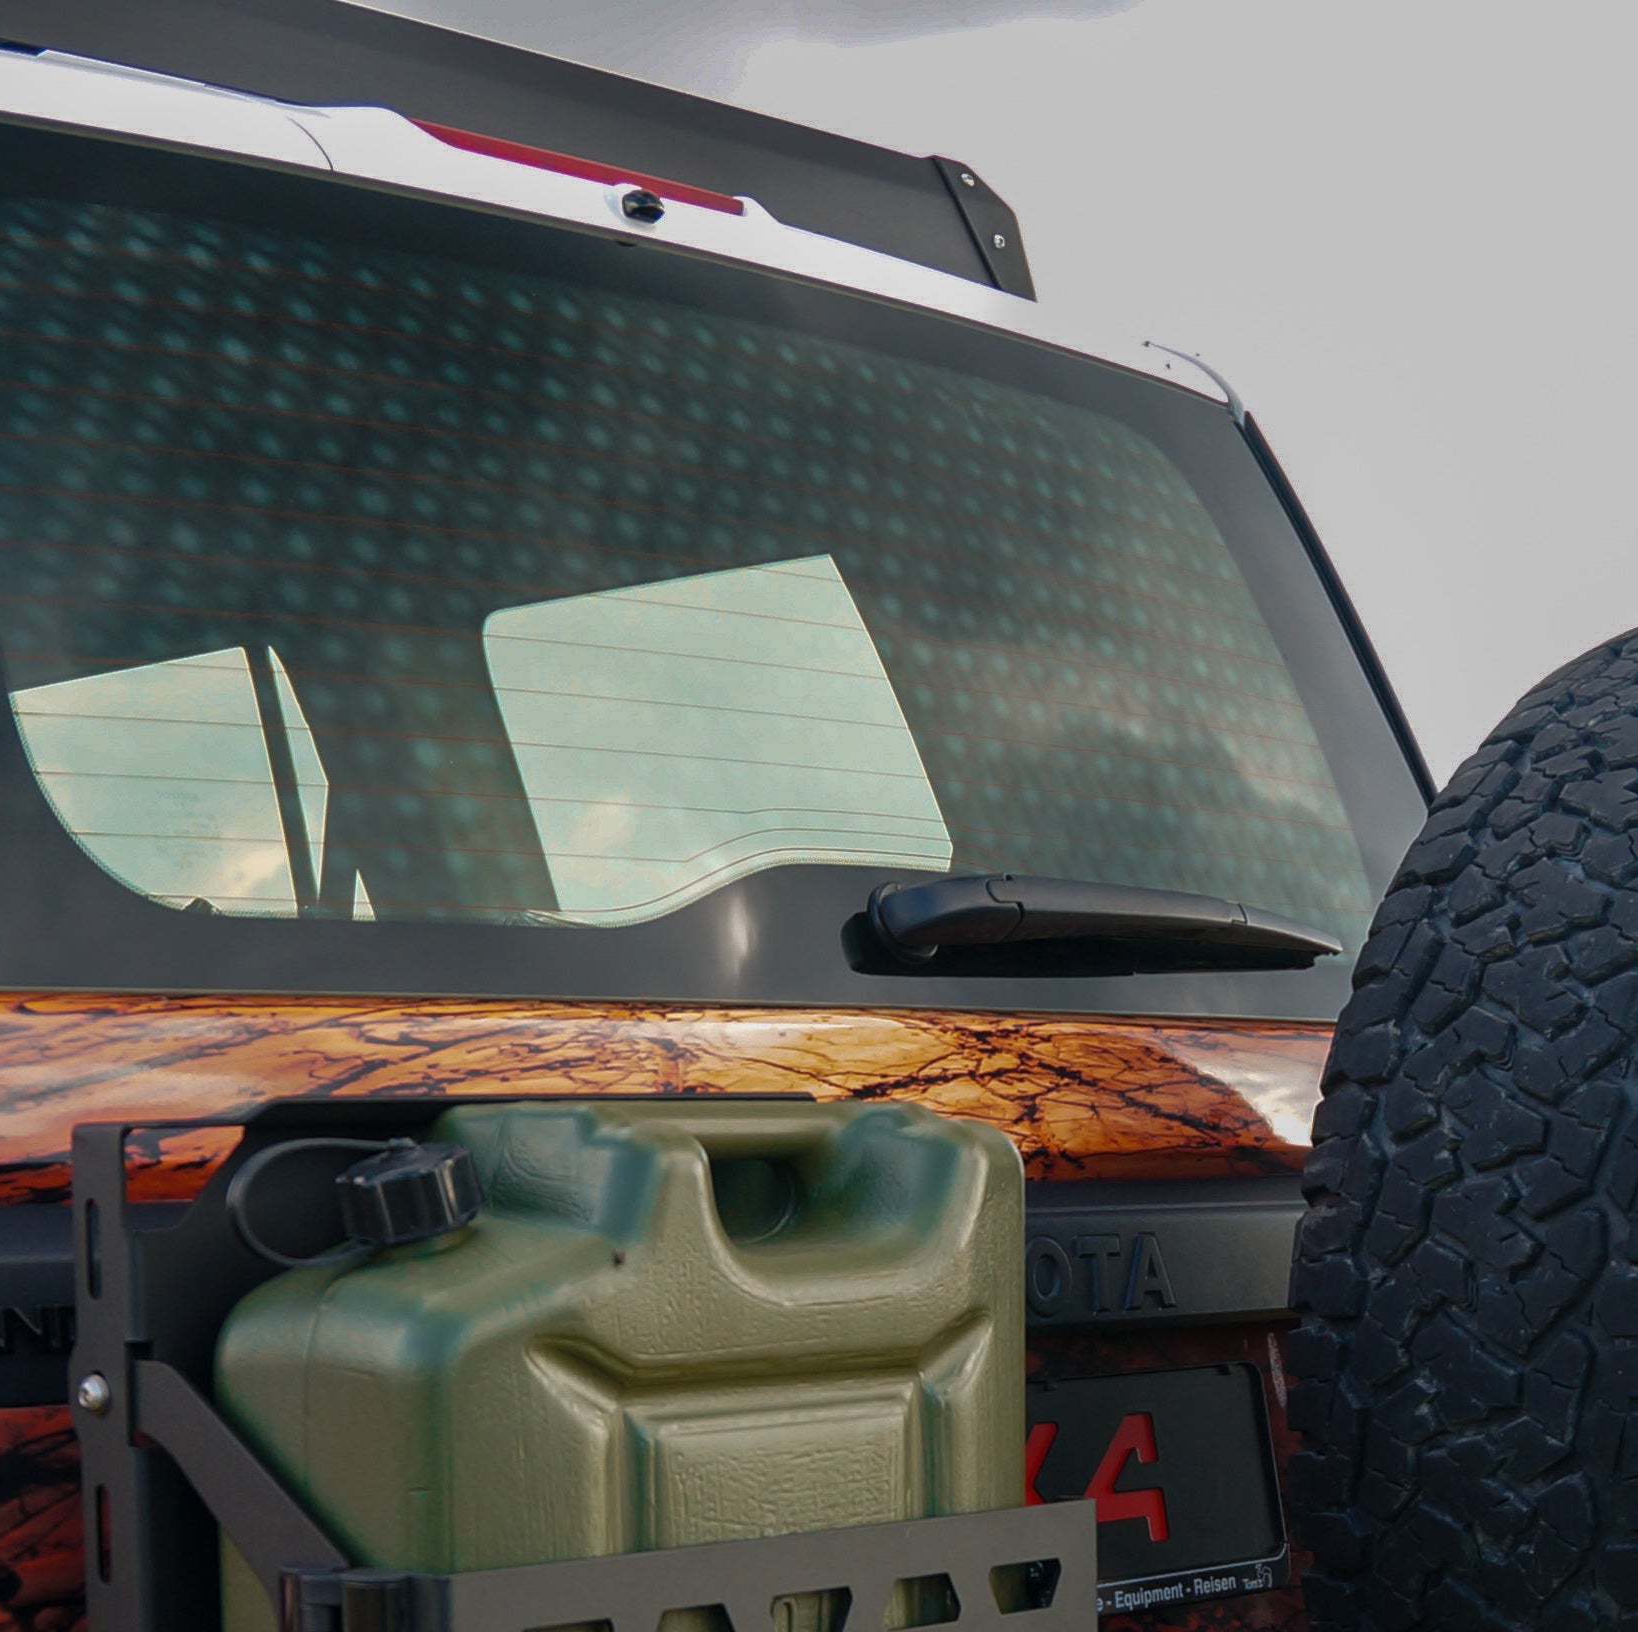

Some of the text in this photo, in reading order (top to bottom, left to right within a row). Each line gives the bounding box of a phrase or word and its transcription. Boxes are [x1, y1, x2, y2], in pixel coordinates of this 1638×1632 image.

[1026, 1231, 1176, 1320] OTA
[1114, 1582, 1183, 1610] Equipment
[1193, 1575, 1237, 1597] Reisen
